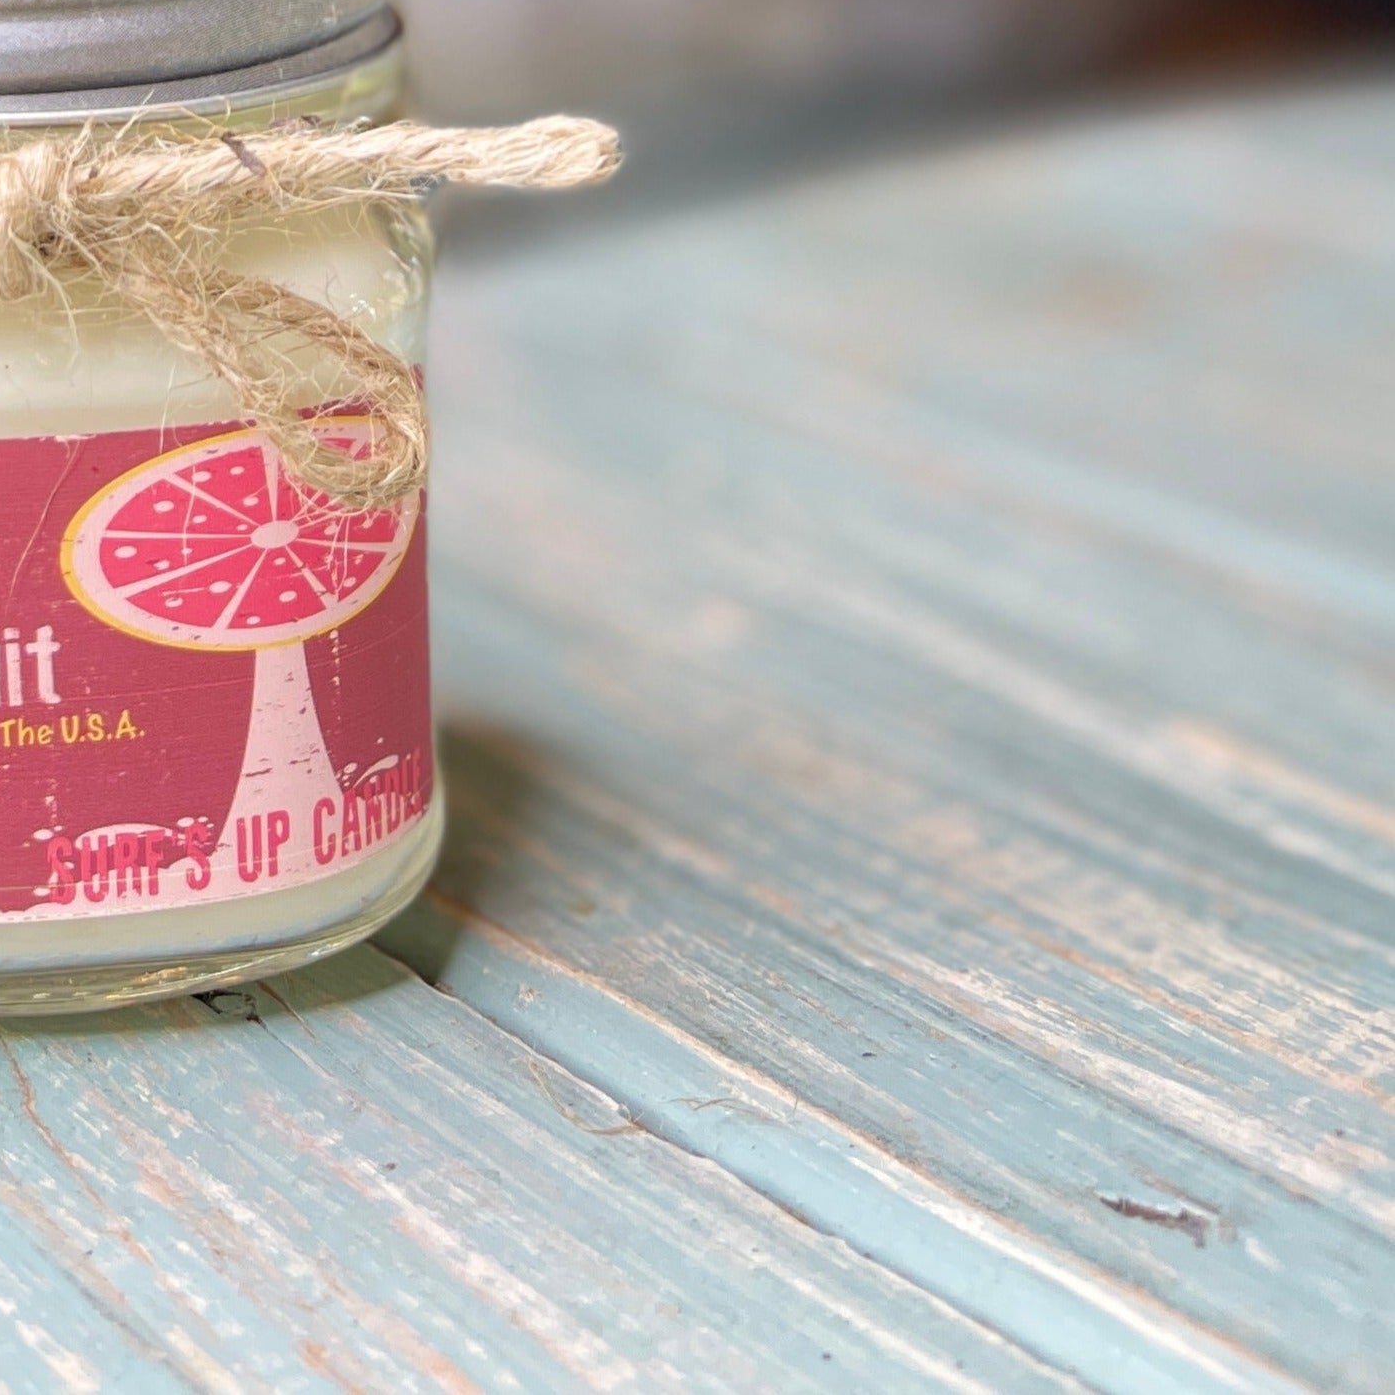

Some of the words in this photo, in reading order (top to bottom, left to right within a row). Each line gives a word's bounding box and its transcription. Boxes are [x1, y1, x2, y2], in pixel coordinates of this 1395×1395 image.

[60, 709, 146, 744] U.S.A.
[46, 823, 215, 905] SURF'S
[236, 809, 291, 883] UP
